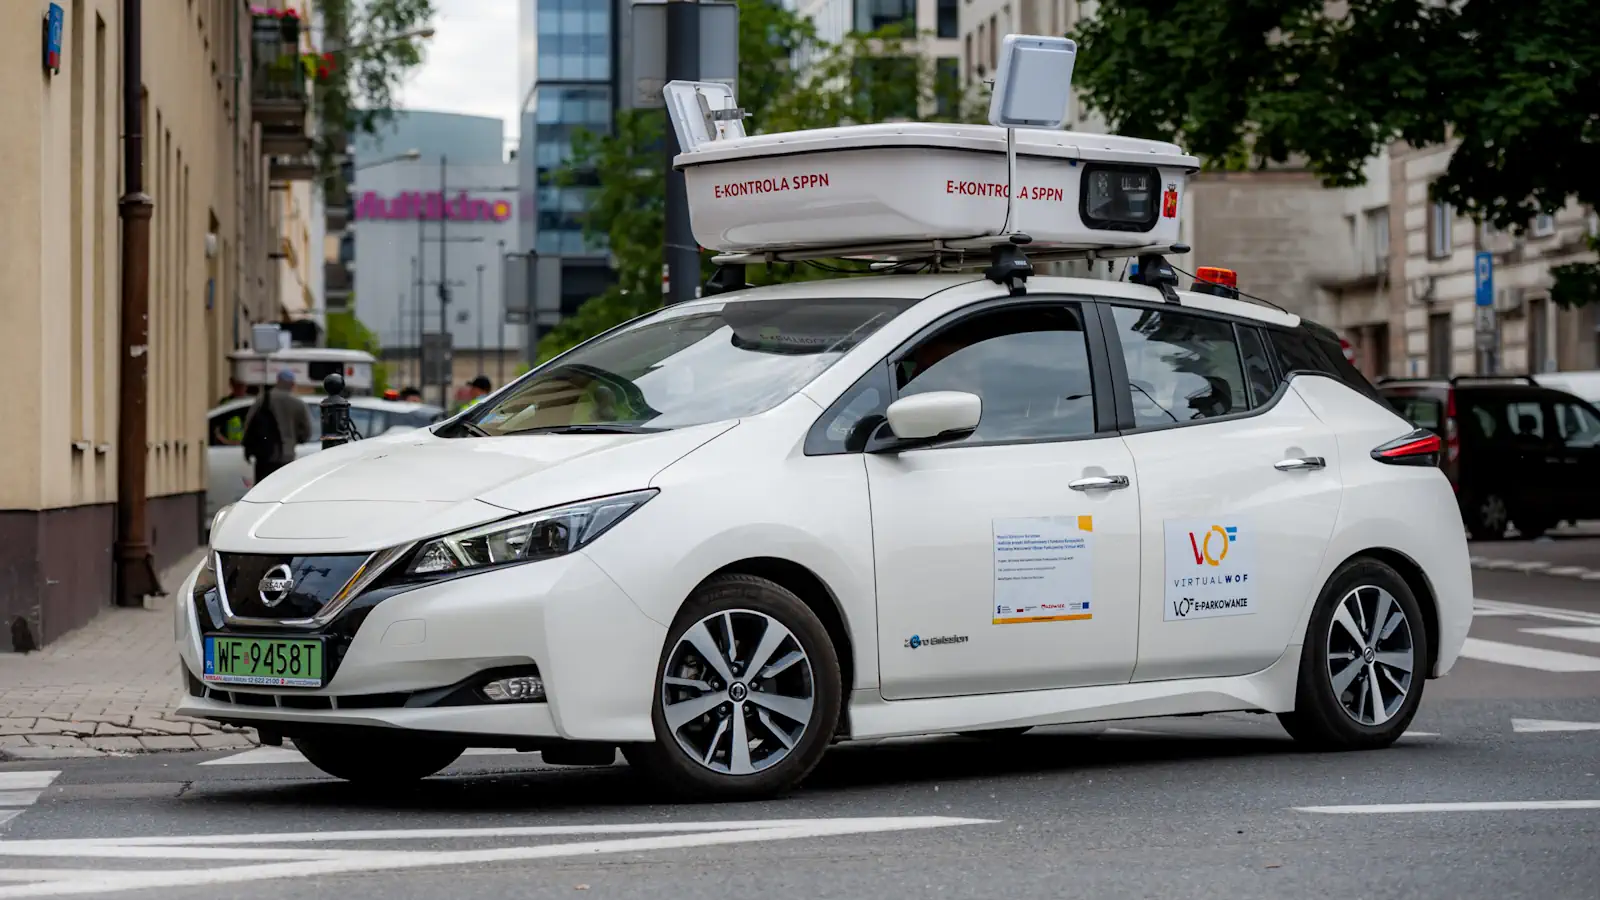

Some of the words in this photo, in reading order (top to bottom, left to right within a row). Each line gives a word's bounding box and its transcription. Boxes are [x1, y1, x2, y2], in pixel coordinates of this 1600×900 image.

[714, 177, 790, 198] E-KONTROLA
[793, 173, 829, 190] SPPN
[946, 180, 1028, 200] E-KONTROA
[1031, 186, 1063, 202] SPPN
[1194, 598, 1248, 611] E-PARKOWANIE
[218, 641, 242, 673] WF
[250, 642, 316, 676] 9458T
[265, 677, 280, 685] 2100
